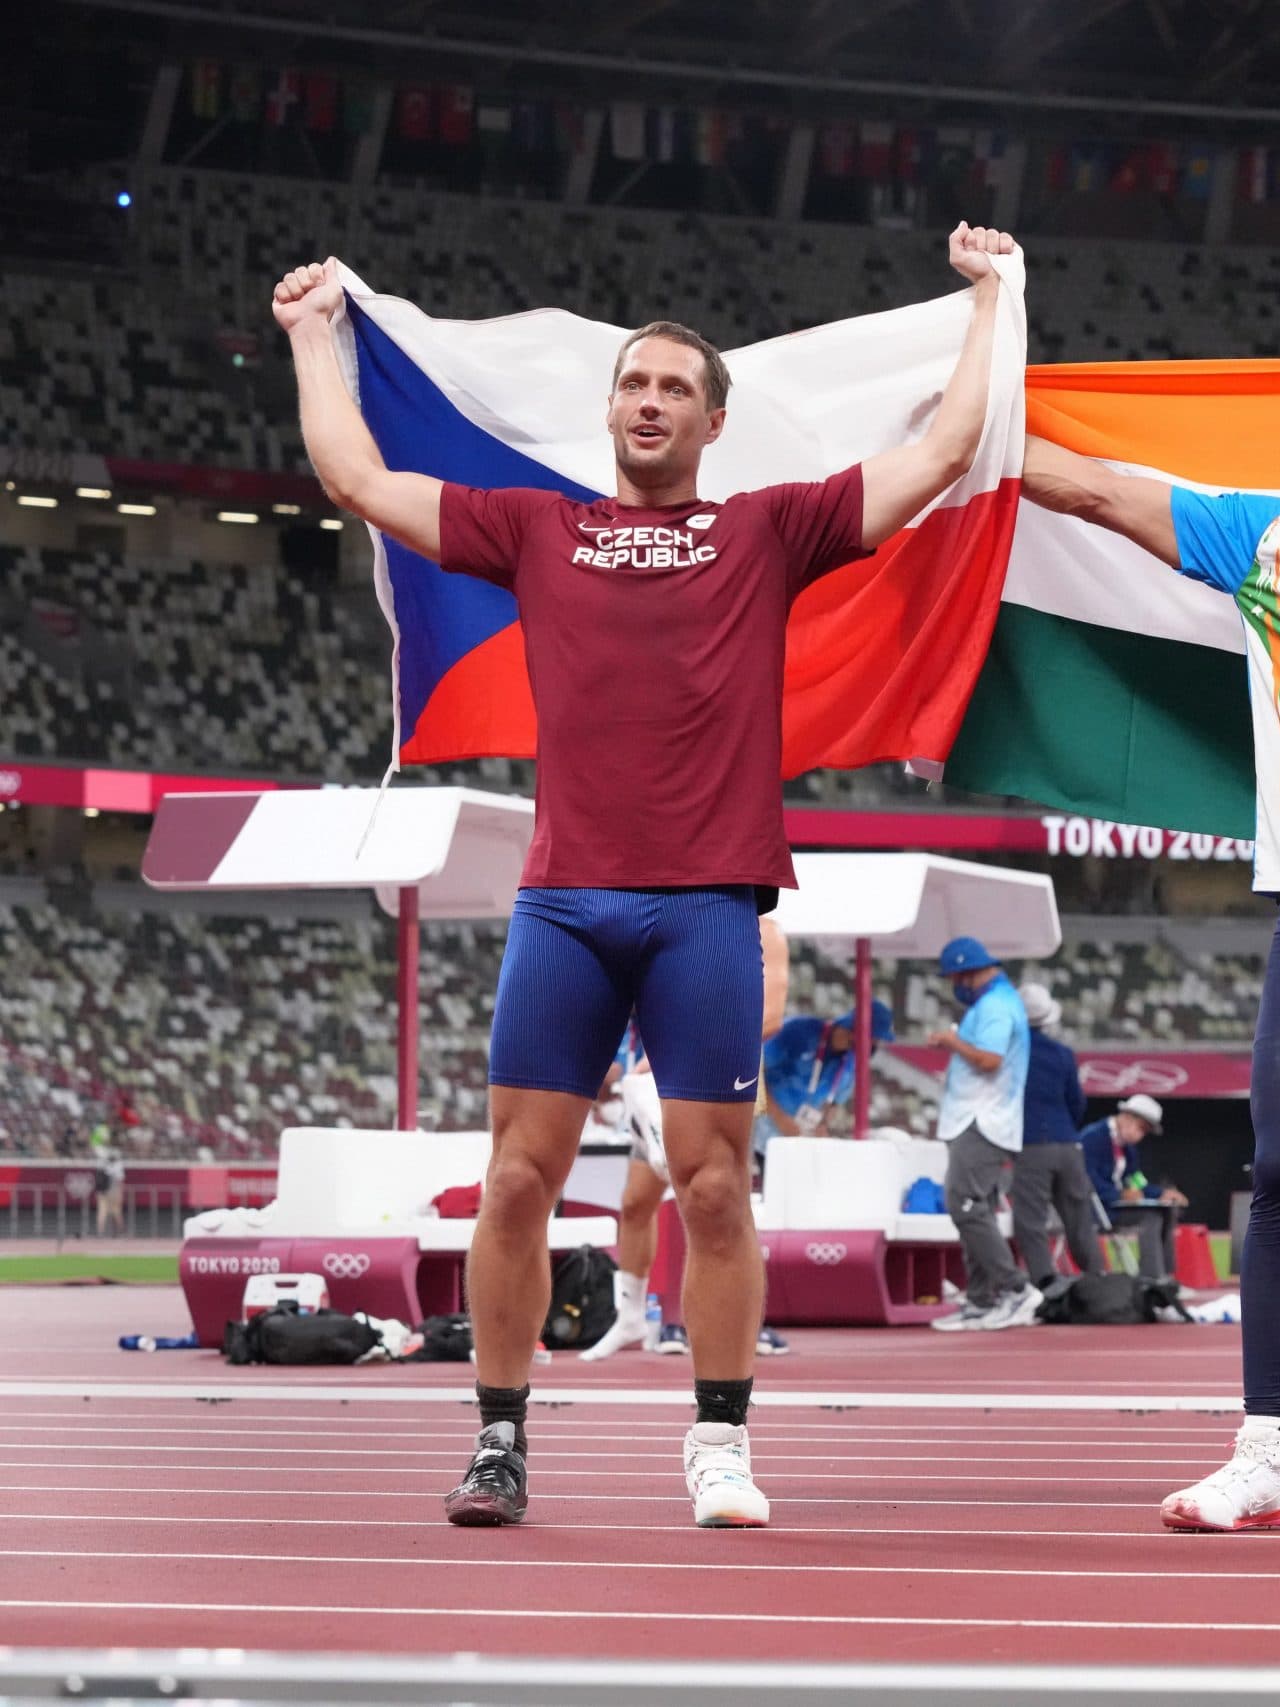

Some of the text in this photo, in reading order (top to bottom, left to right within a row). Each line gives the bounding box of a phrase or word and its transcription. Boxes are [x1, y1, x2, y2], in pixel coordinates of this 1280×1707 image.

[597, 527, 694, 550] CZECH
[572, 546, 718, 569] REPUBLIC
[1042, 815, 1163, 858] TOKYO
[188, 1256, 280, 1274] TOKYO 2020
